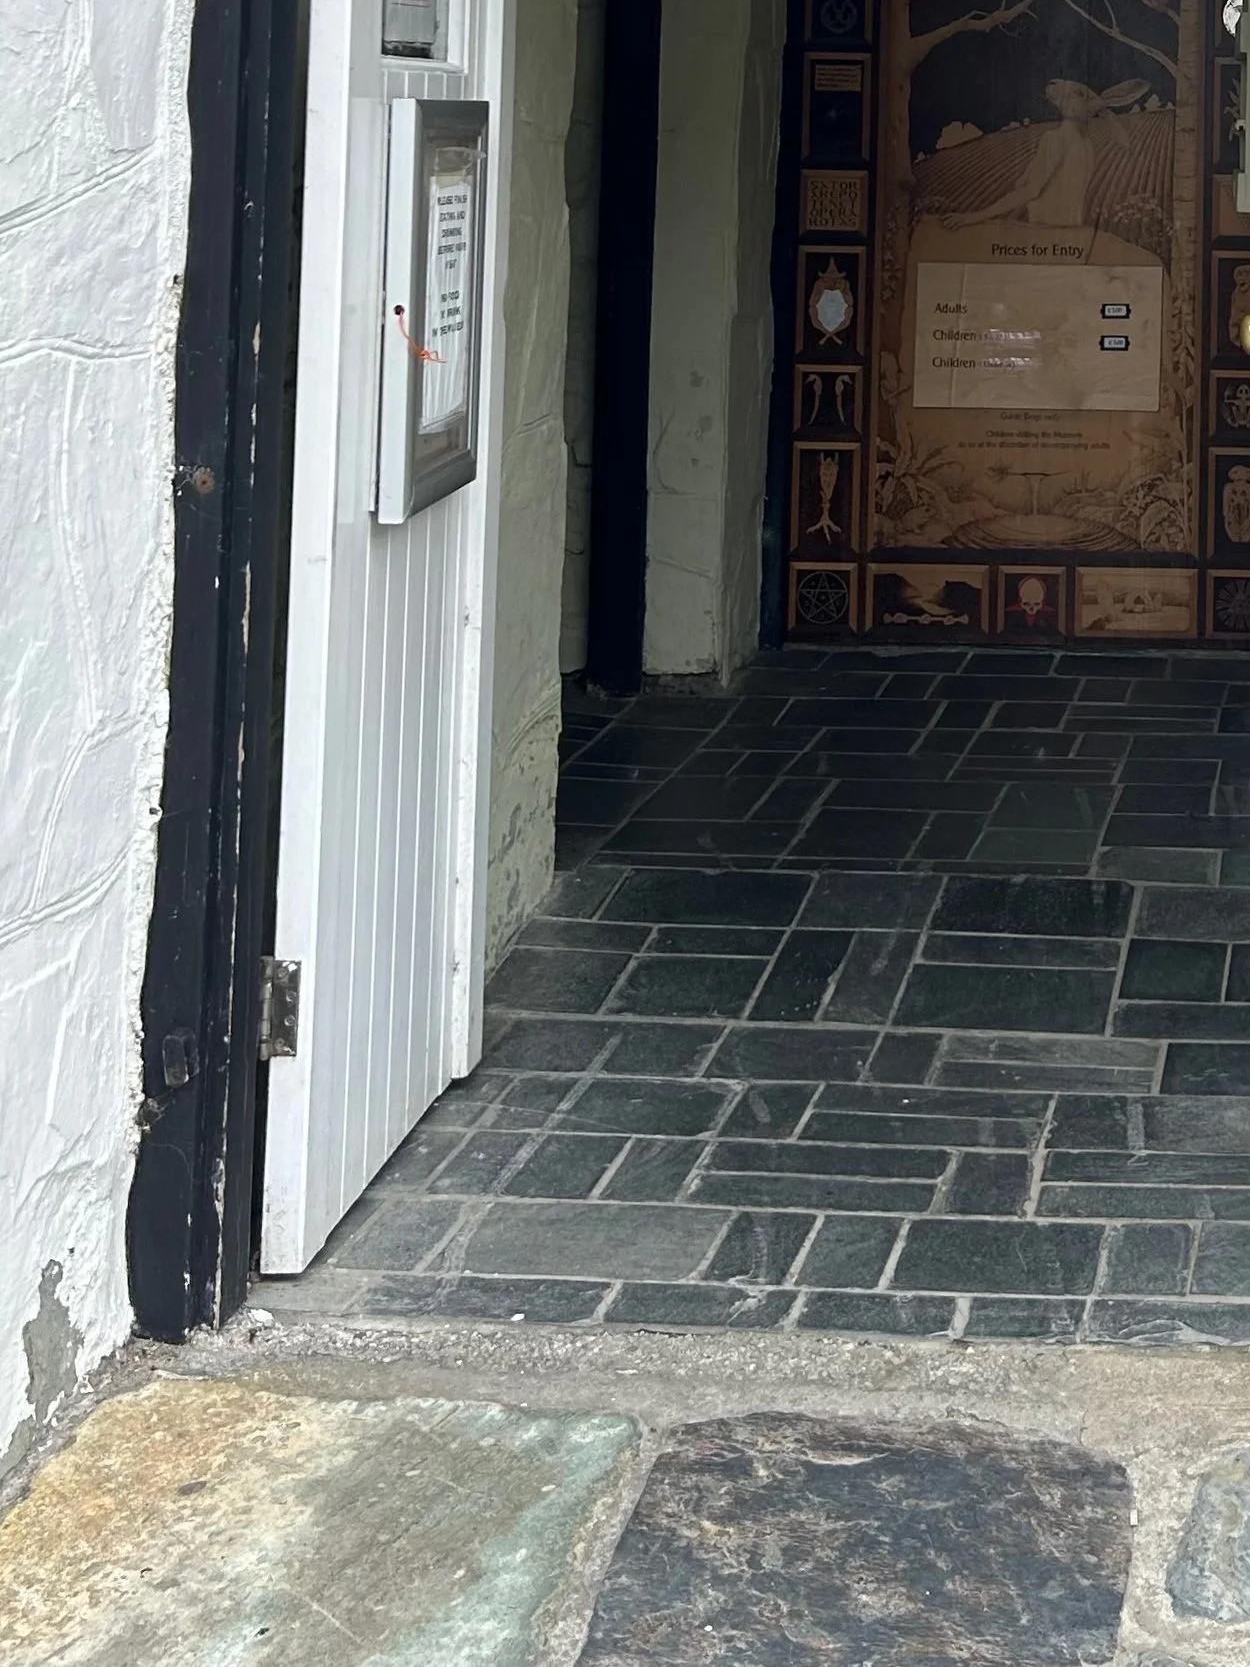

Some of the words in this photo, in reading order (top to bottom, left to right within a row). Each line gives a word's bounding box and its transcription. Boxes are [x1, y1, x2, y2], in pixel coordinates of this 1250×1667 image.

[991, 243, 1027, 256] Prices
[1031, 243, 1050, 256] for
[1052, 244, 1084, 259] Entry
[935, 303, 968, 314] Adults
[932, 329, 976, 341] Children
[932, 357, 976, 368] Children
